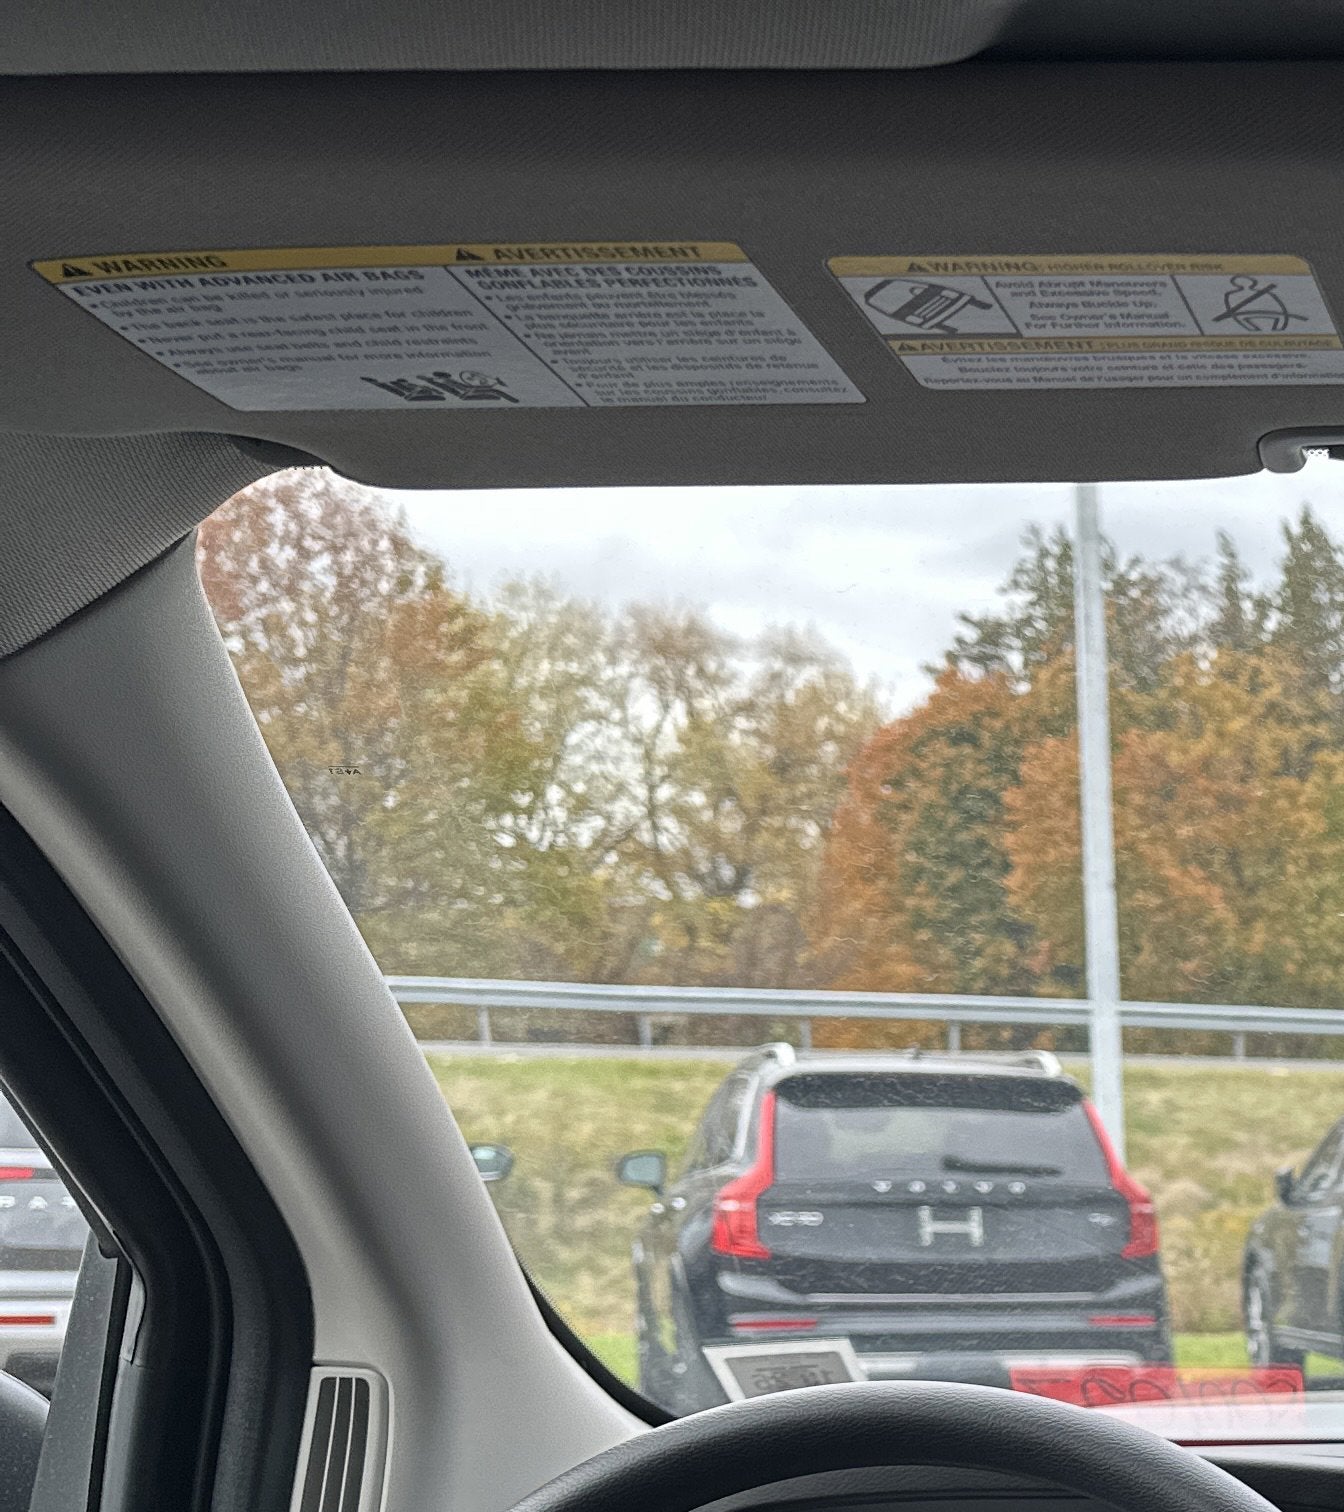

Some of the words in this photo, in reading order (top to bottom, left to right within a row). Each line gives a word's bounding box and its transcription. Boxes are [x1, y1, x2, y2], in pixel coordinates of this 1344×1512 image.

[494, 246, 702, 260] AVERTISSEMENT
[93, 255, 227, 275] WARNING
[529, 266, 580, 278] AVEC
[583, 265, 622, 276] DES
[625, 264, 722, 278] COUSSINS
[72, 282, 133, 297] EVEN
[134, 278, 195, 291] WITH
[199, 272, 316, 287] ADVANCED
[322, 271, 360, 283] AIR
[362, 270, 425, 281] BAGS
[477, 277, 601, 290] GONFLABLES
